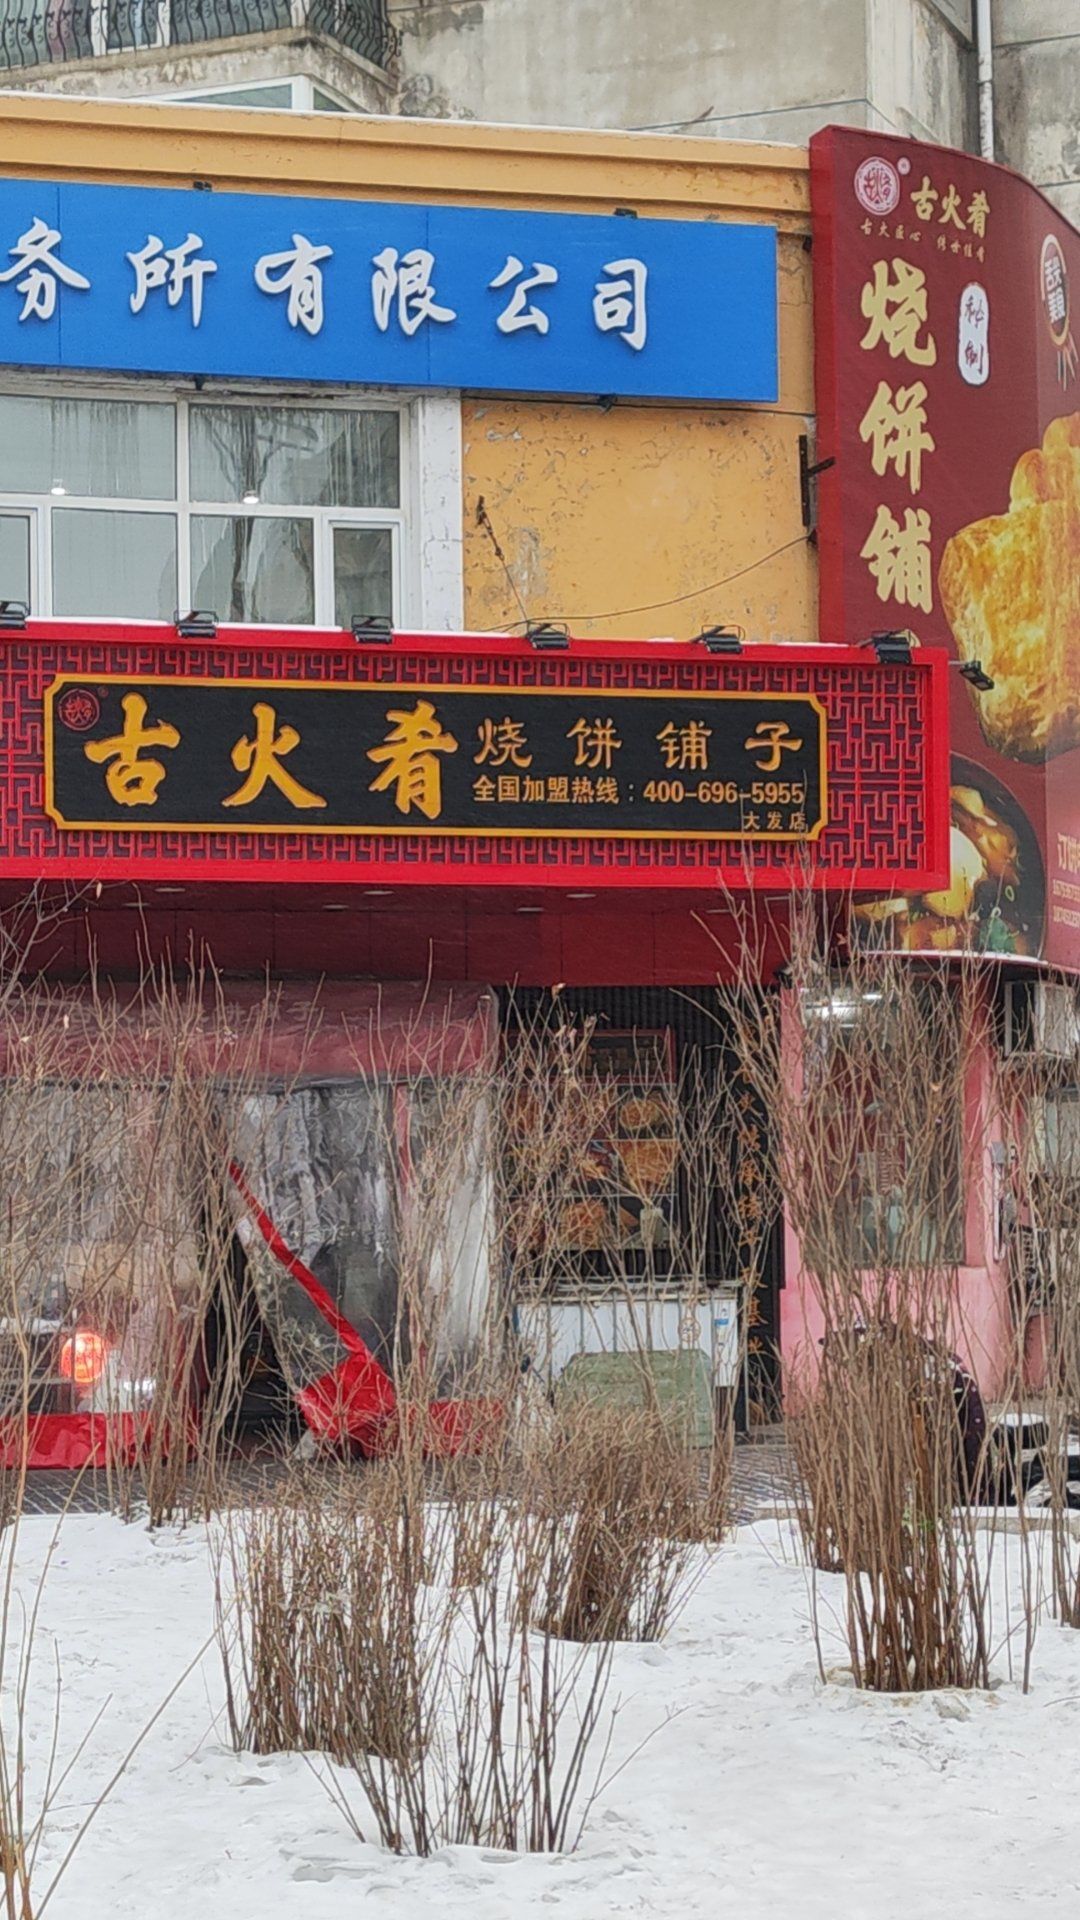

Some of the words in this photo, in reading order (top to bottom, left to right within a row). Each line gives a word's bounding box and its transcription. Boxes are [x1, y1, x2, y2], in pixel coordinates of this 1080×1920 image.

[910, 175, 991, 239] 古火肴
[0, 216, 649, 352] 务所有限公司
[859, 257, 937, 614] 烧饼铺
[84, 692, 459, 820] 古火肴
[473, 716, 803, 771] 烧饼铺子
[743, 810, 807, 830] 大发店
